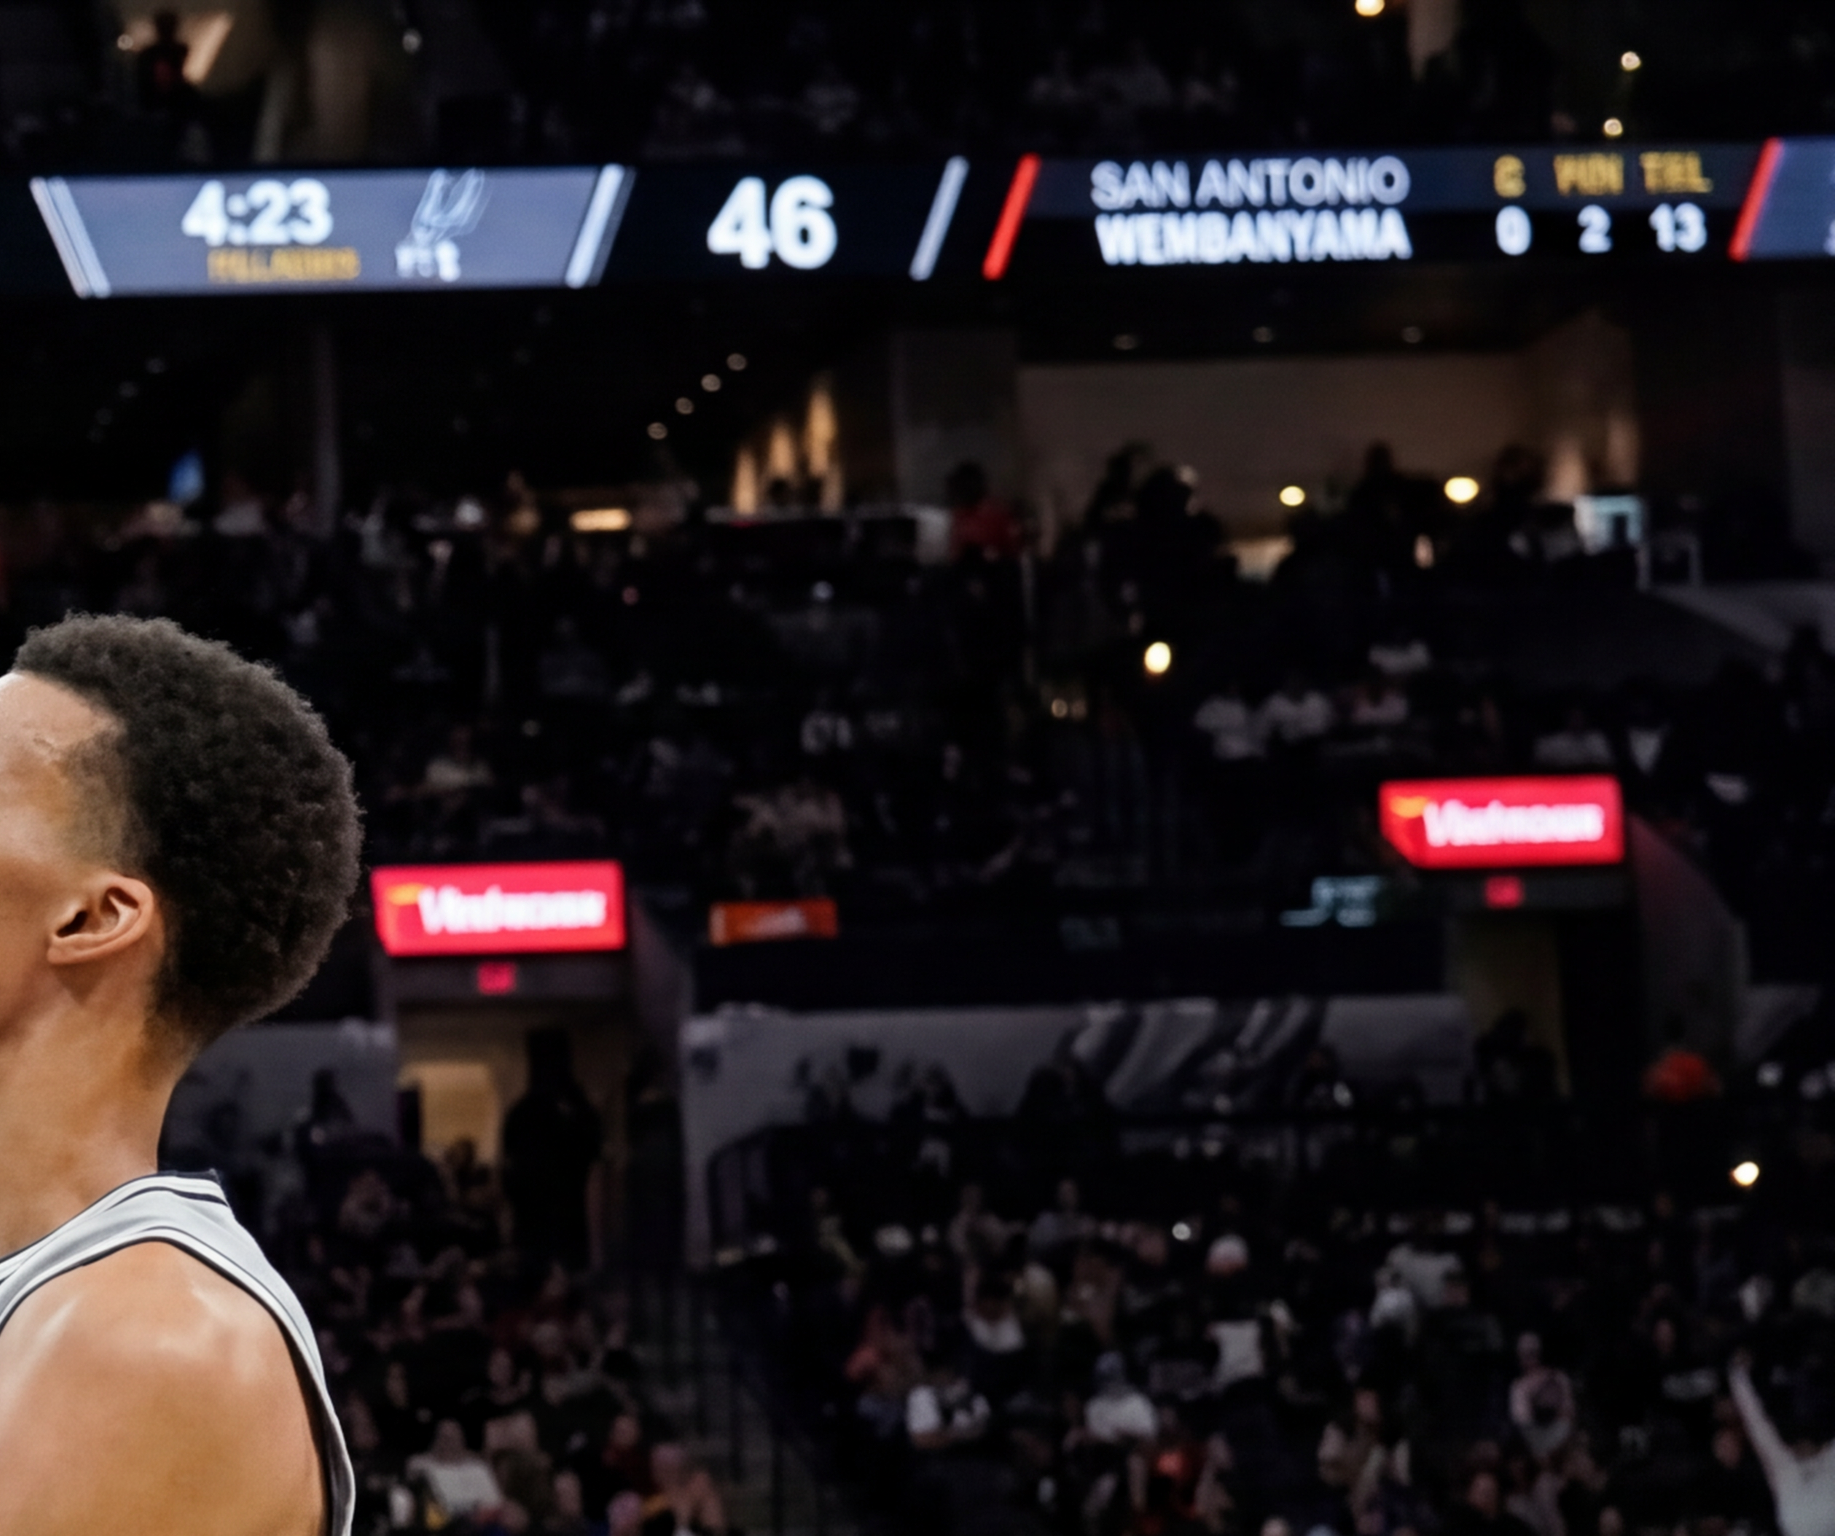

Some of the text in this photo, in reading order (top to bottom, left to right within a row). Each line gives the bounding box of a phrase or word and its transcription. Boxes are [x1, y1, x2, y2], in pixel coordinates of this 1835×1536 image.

[181, 178, 333, 246] 4:23
[1091, 155, 1411, 210] SAN ANTONIO
[708, 175, 838, 272] 46
[1578, 204, 1612, 253] 2
[1648, 203, 1707, 252] 13
